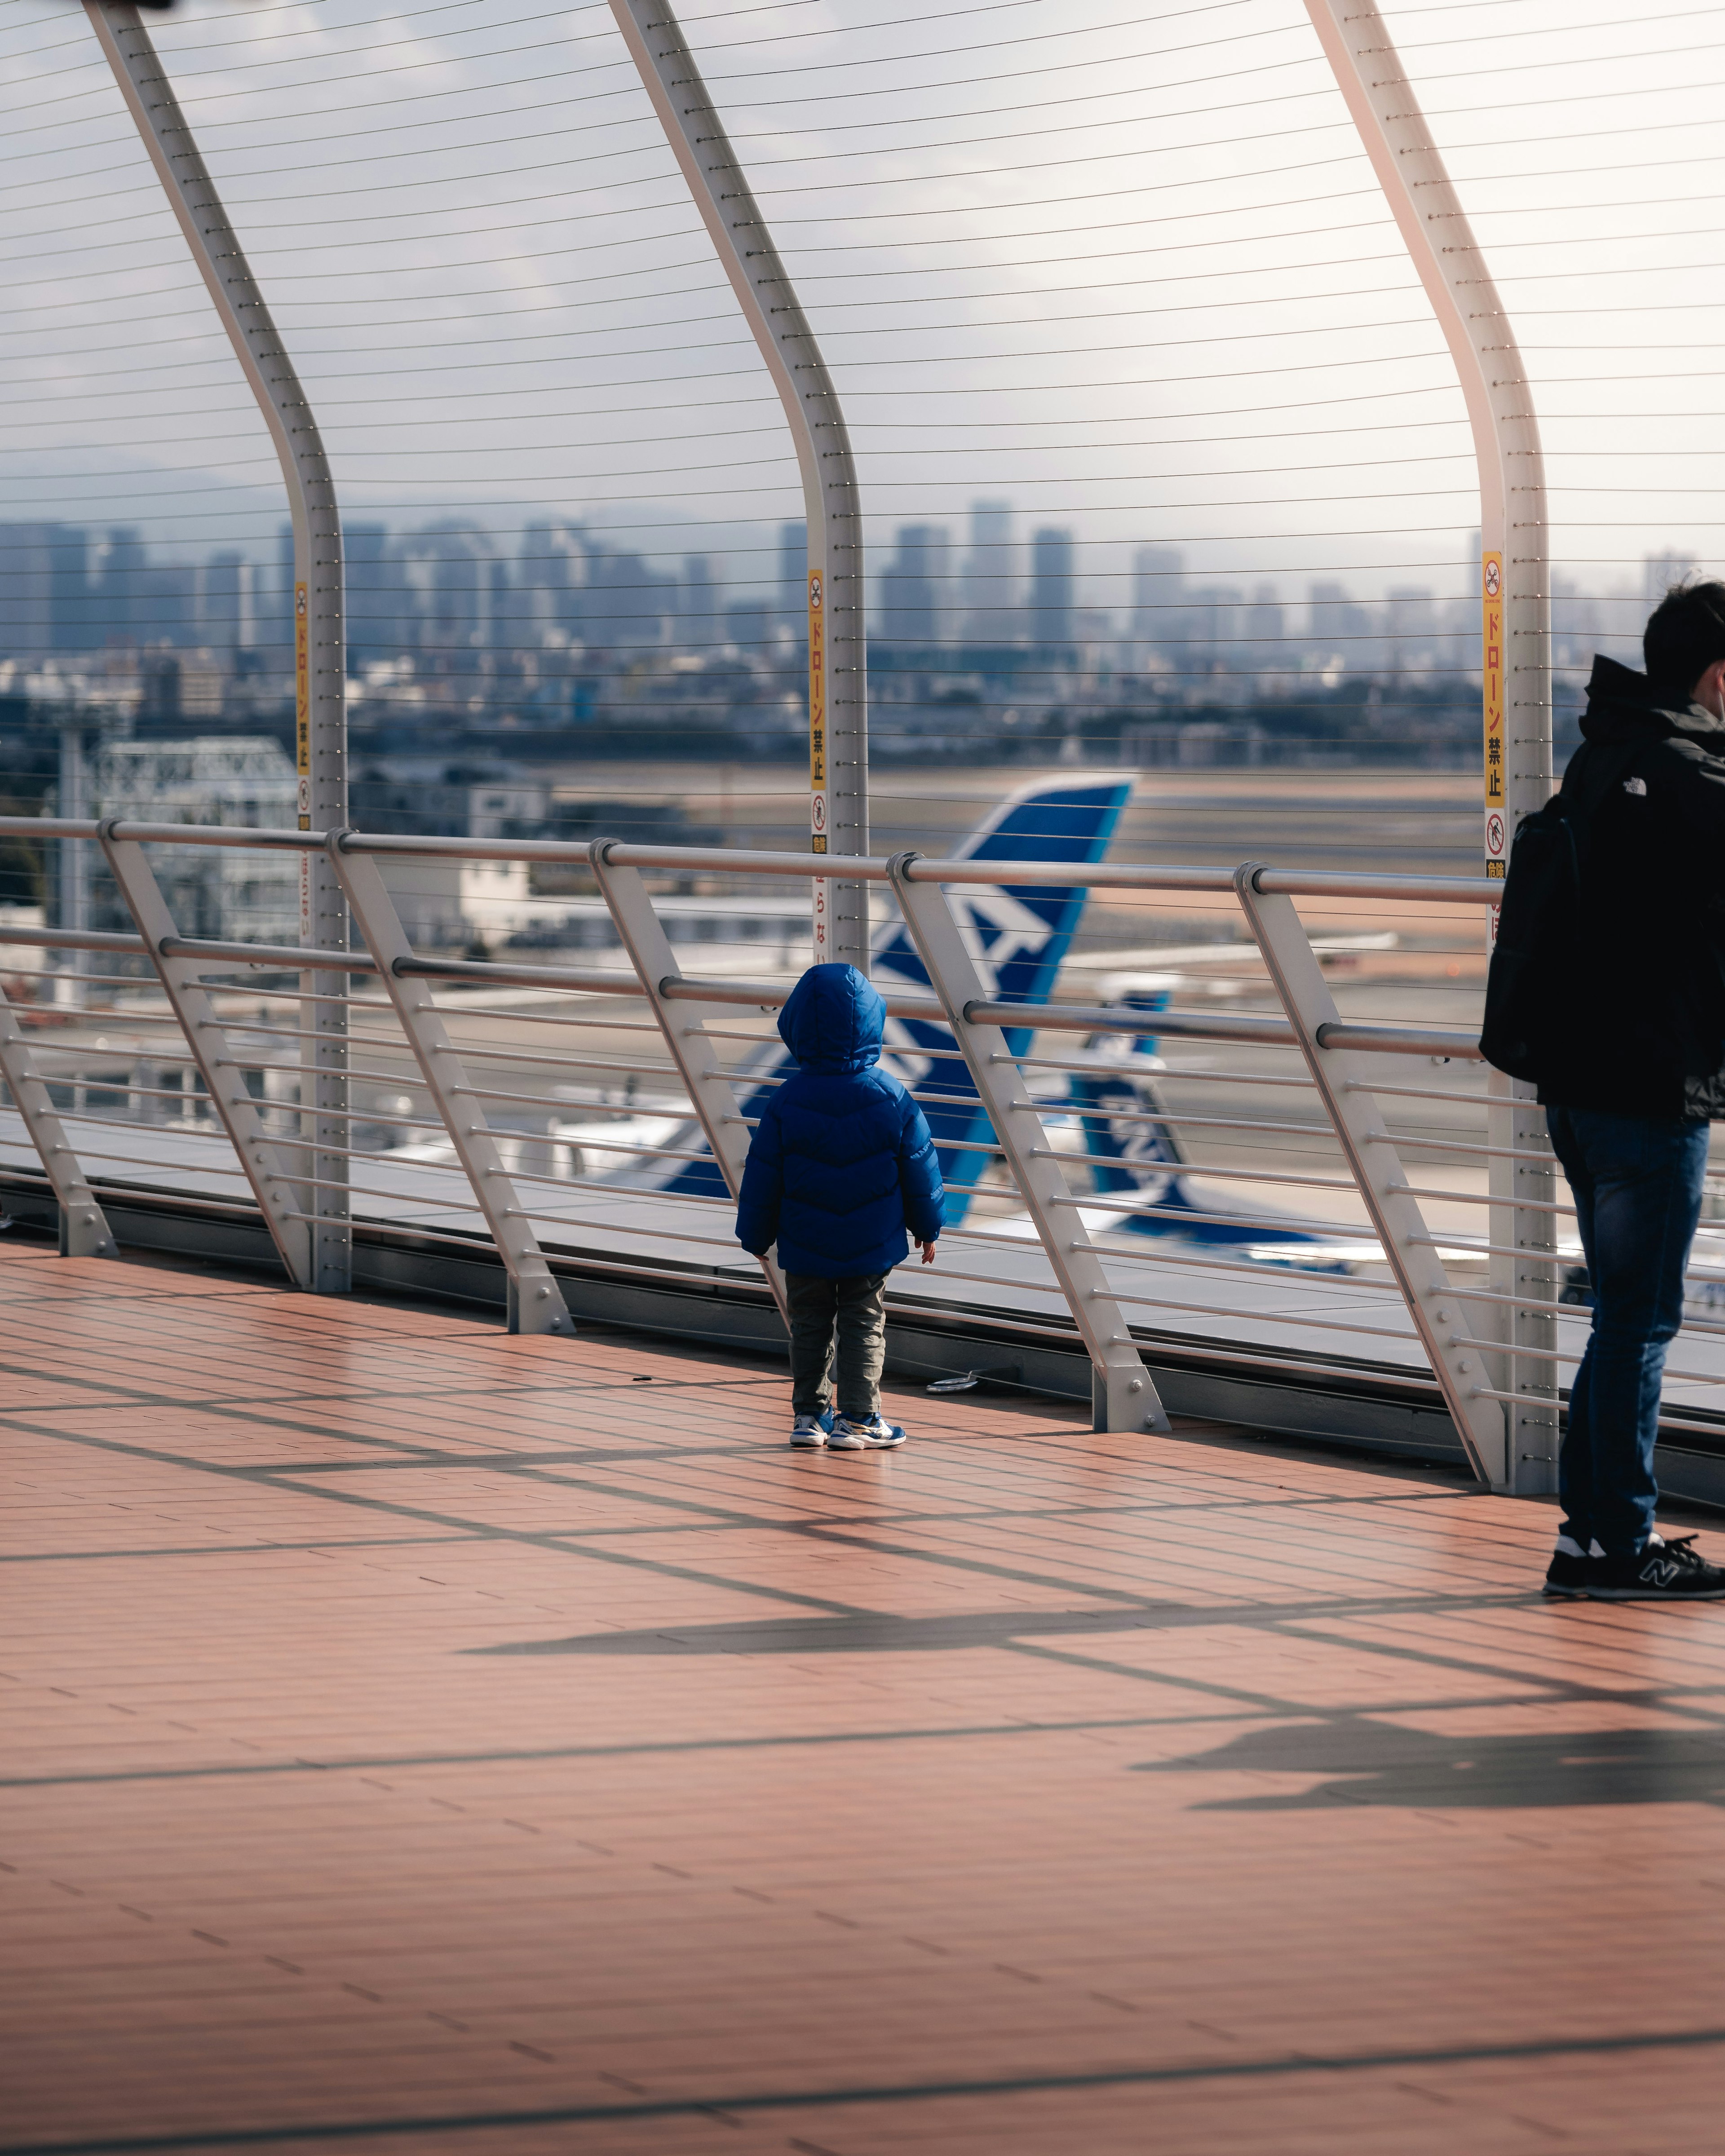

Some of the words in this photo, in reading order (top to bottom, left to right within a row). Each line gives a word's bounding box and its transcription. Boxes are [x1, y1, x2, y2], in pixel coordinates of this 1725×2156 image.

[813, 622, 823, 780] ドローン禁止
[1488, 613, 1501, 796] ドローン禁止
[1488, 862, 1504, 879] 危険
[1639, 1558, 1681, 1587] N
